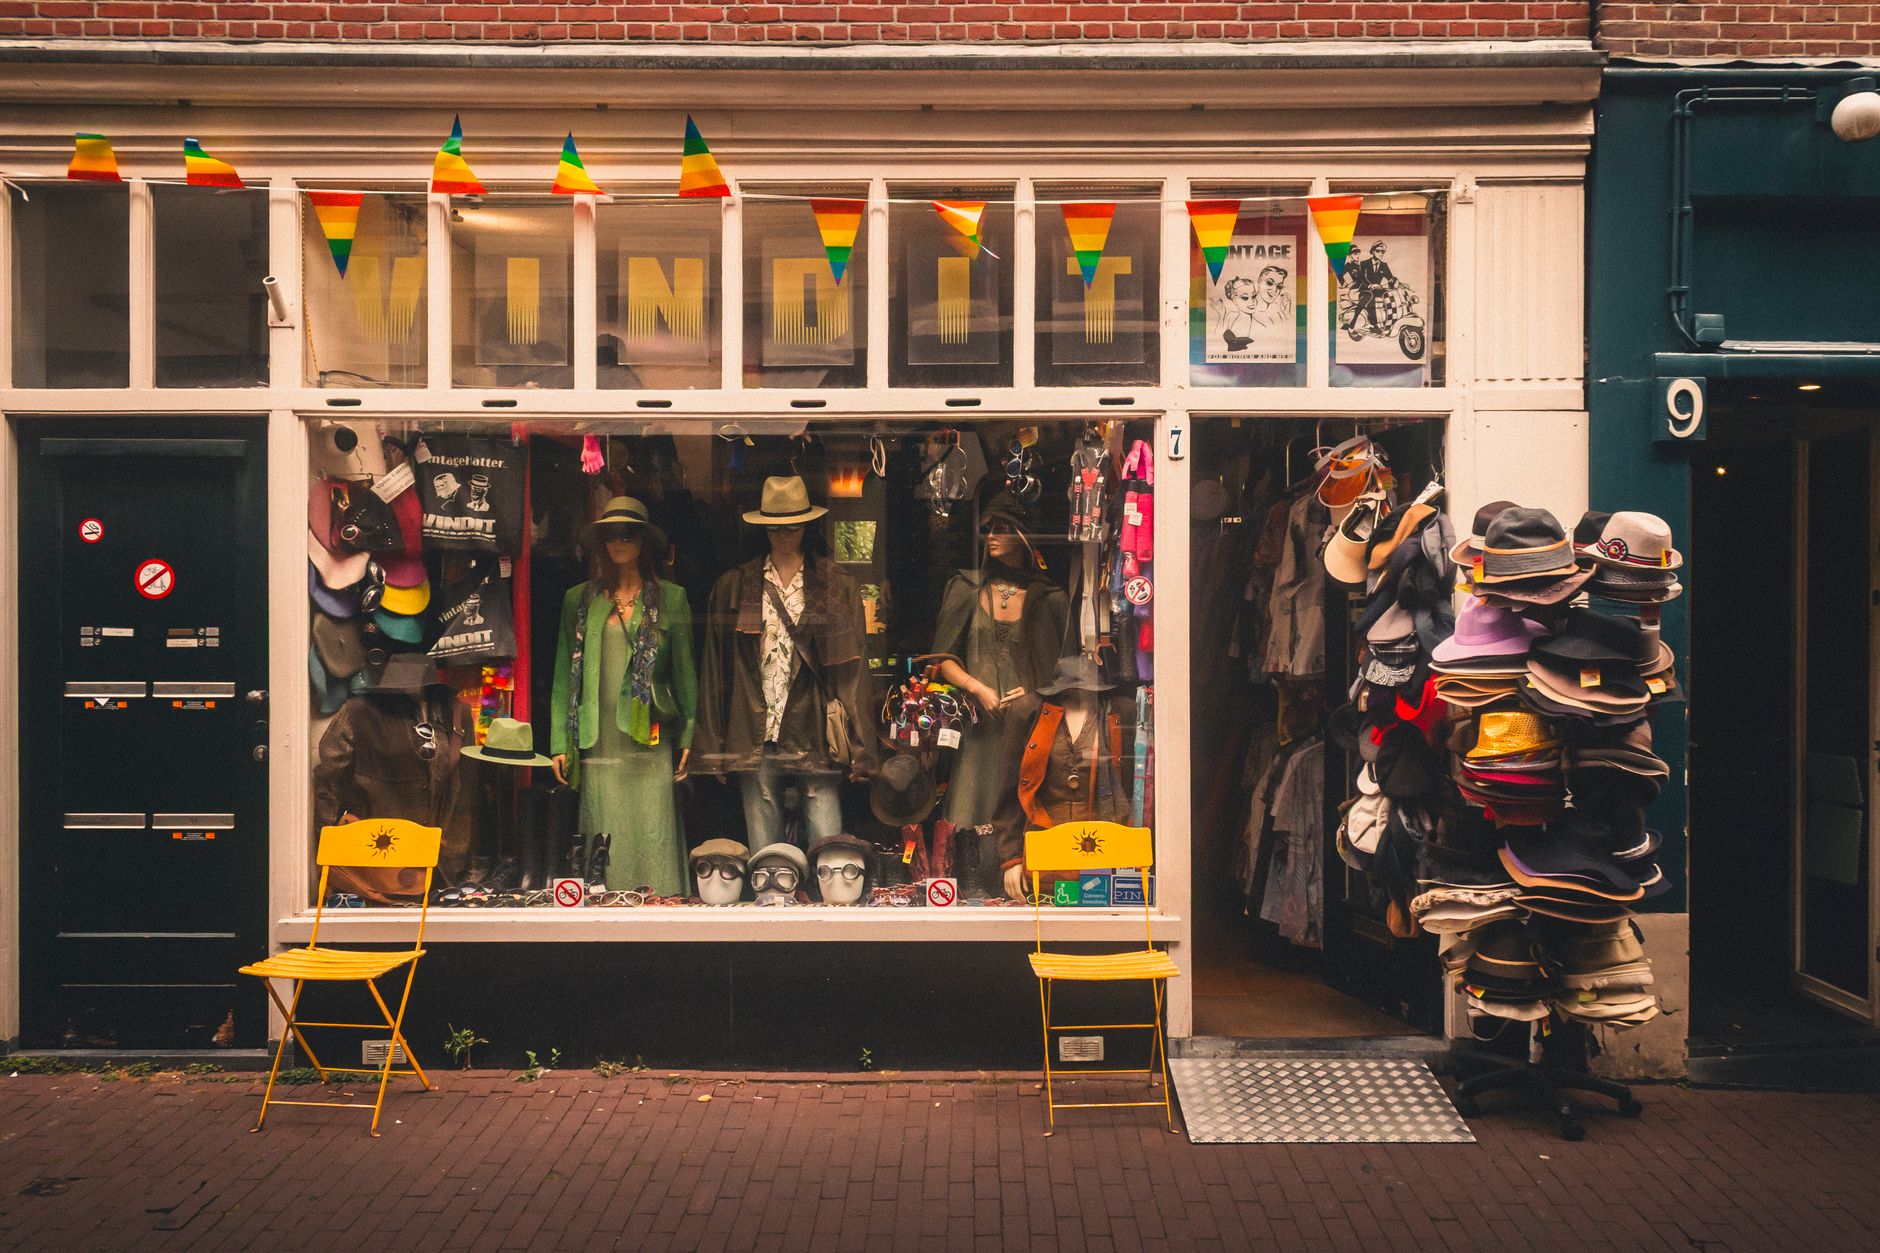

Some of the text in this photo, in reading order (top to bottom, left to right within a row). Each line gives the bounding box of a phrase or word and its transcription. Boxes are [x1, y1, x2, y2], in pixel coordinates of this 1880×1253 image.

[1229, 244, 1291, 260] NTAGE
[1667, 377, 1704, 438] 9
[1170, 429, 1183, 455] 7
[428, 455, 505, 468] ntageHatter
[423, 513, 496, 533] VINDIT
[431, 629, 493, 650] INDIT
[1113, 891, 1142, 900] PIN
